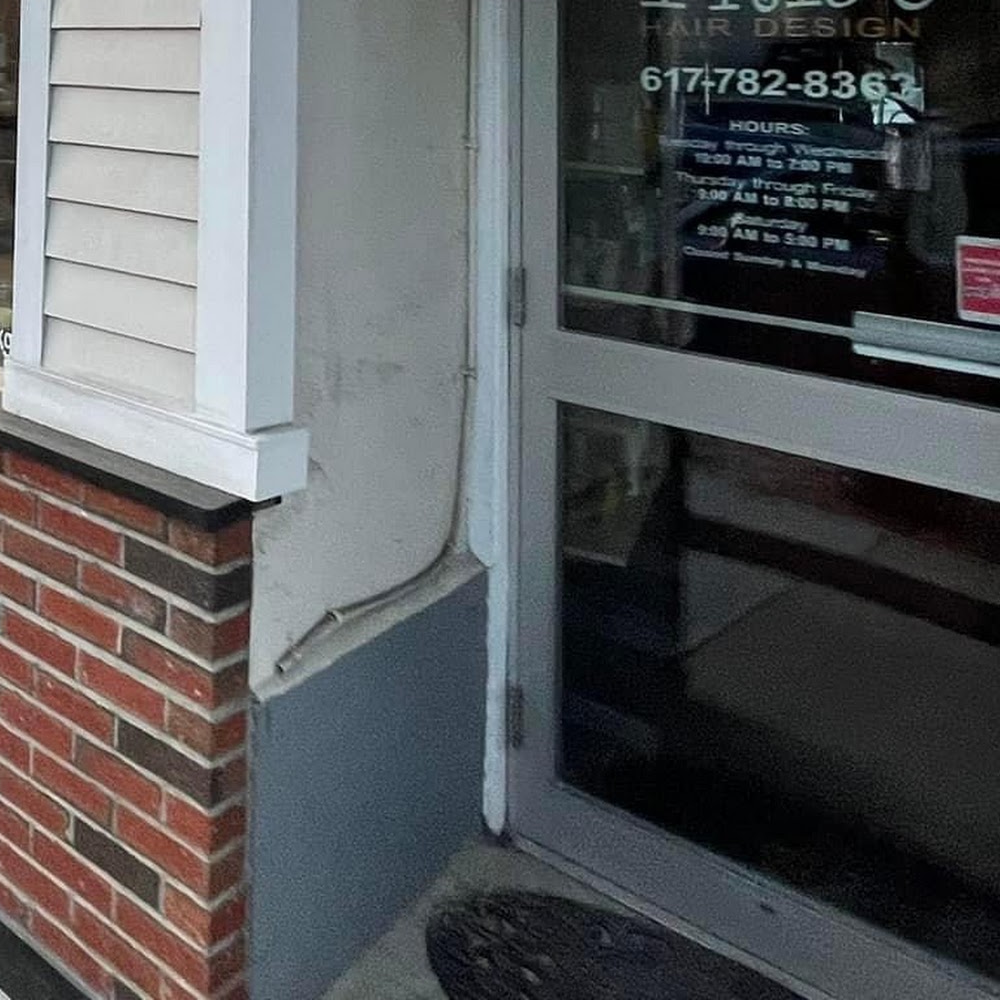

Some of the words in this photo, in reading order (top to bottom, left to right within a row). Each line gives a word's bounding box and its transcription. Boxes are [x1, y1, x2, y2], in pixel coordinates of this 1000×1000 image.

[641, 17, 731, 37] HAIR
[754, 16, 921, 38] DESIGN
[729, 119, 810, 135] HOURS:
[736, 155, 762, 167] AM
[766, 157, 783, 169] to
[825, 160, 853, 174] PM
[675, 171, 746, 190] Thursday
[752, 177, 816, 196] through
[822, 182, 876, 201] Friday
[732, 191, 758, 204] AM
[762, 194, 779, 206] to
[821, 199, 850, 213] PM
[732, 228, 759, 241] AM
[763, 232, 781, 243] to
[822, 237, 850, 251] PM
